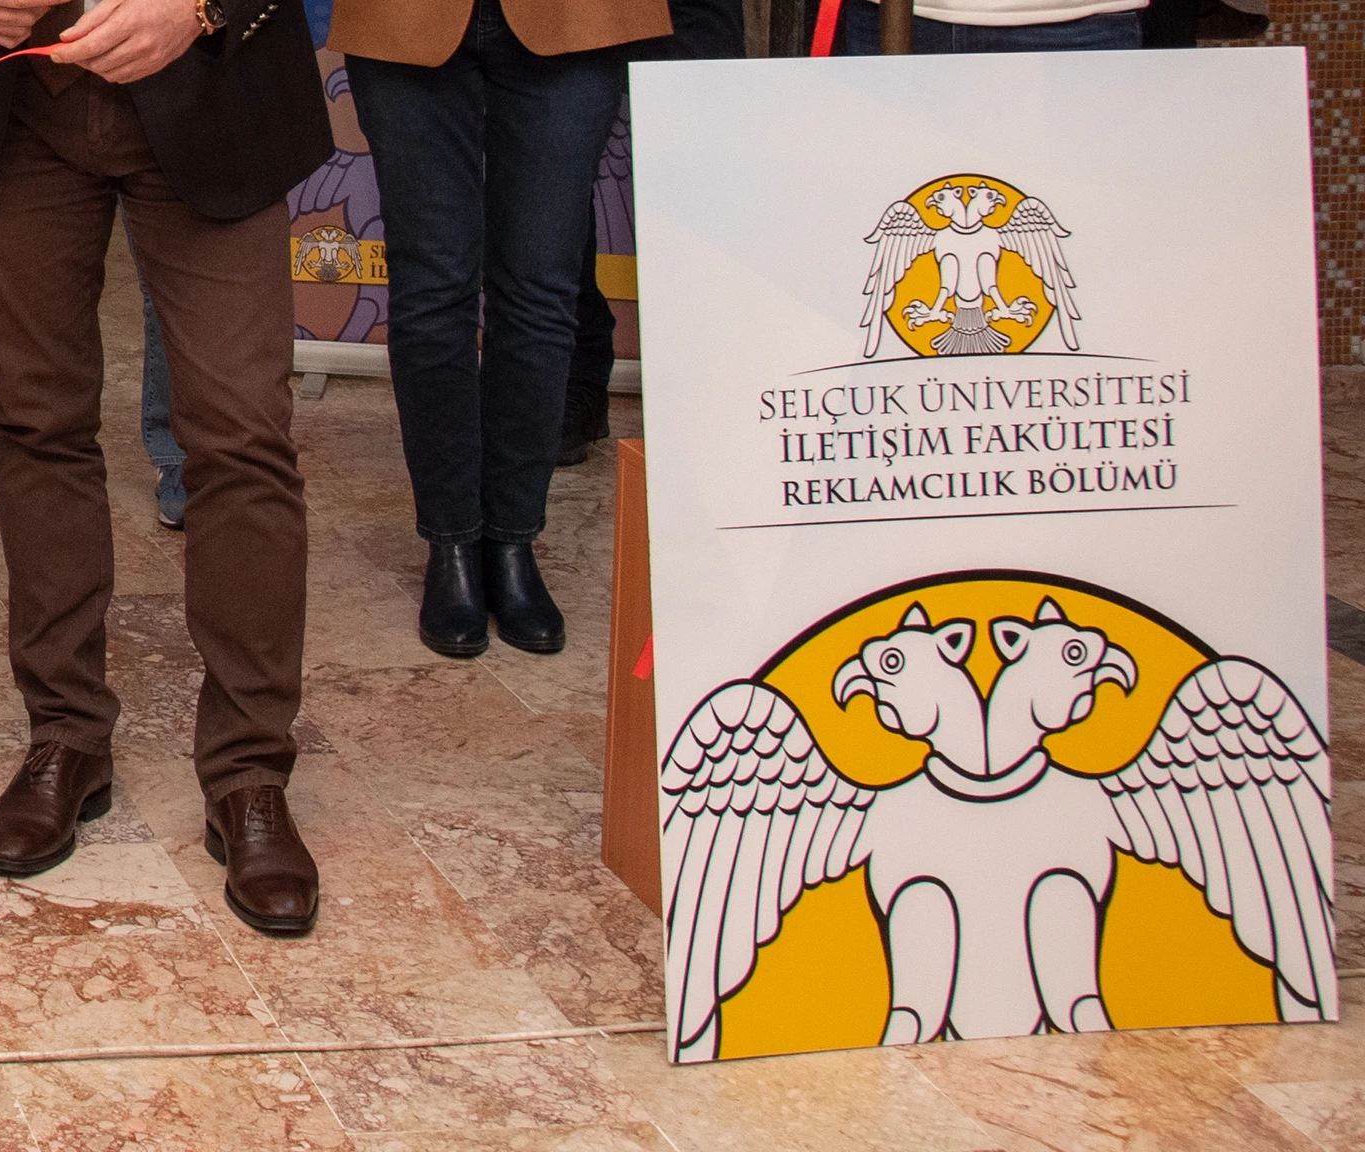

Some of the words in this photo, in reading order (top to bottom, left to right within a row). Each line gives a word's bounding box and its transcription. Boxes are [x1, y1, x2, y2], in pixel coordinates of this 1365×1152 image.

[759, 384, 909, 425] SELÇUK
[918, 369, 1192, 414] ÜNİVERSİTESİ
[779, 423, 954, 468] İLETİŞİM
[964, 413, 1176, 455] FAKÜLTESİ
[782, 470, 1018, 507] REKLAMCILIK
[1027, 459, 1178, 496] BÖLÜMÜ
